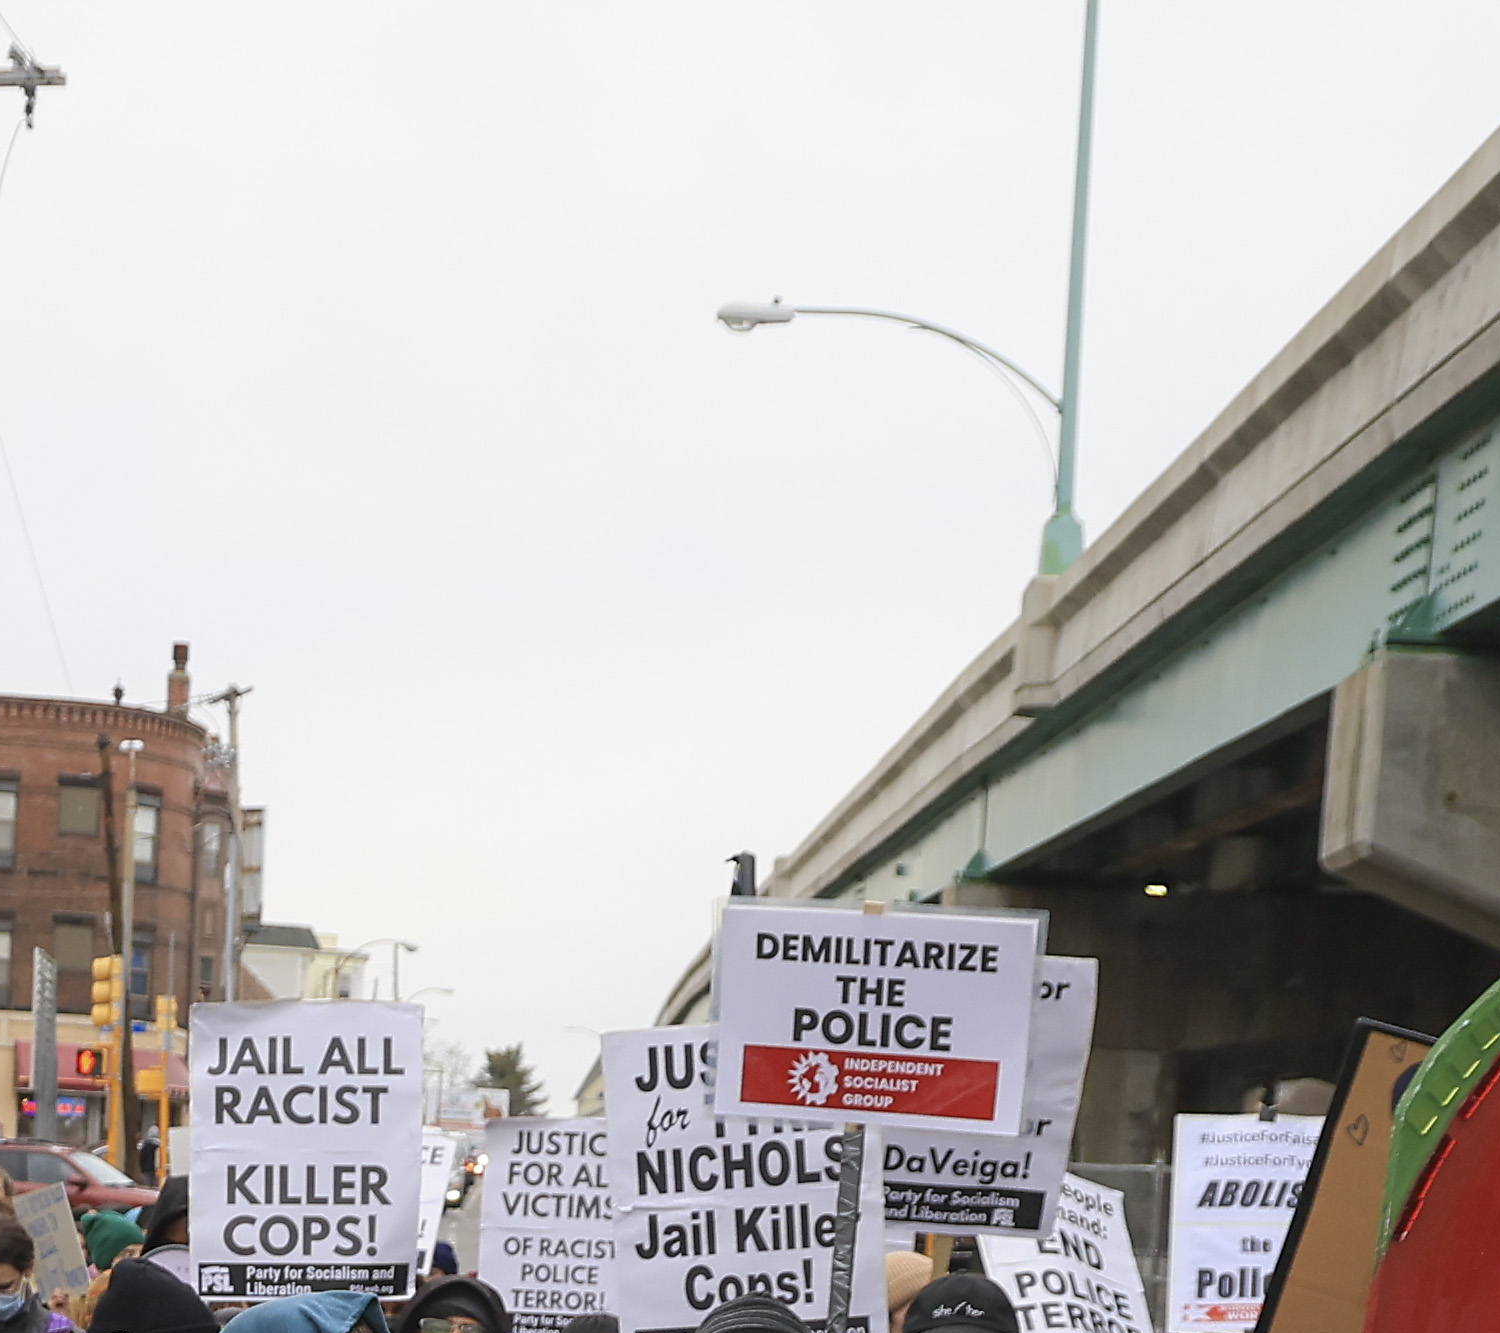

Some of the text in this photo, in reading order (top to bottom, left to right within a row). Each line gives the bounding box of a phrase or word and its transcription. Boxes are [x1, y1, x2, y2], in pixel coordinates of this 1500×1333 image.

[756, 932, 999, 973] DEMILITARIZE
[836, 975, 906, 1008] THE
[792, 1007, 954, 1052] POLICE
[208, 1036, 405, 1076] JAIL ALL
[843, 1057, 945, 1077] INDEPENDENT
[842, 1075, 919, 1093] SOCIALIST
[214, 1085, 388, 1125] RACIST
[841, 1093, 894, 1108] GROUP
[645, 1096, 690, 1148] for
[512, 1130, 608, 1156] JUSTIC
[1200, 1130, 1320, 1144] #JusticeForFaisa
[508, 1161, 610, 1188] FOR AL
[637, 1135, 845, 1195] NICHOLS
[883, 1144, 1032, 1184] DaVeiga!
[226, 1164, 392, 1206] KILLER
[925, 1188, 948, 1203] for
[950, 1191, 1020, 1208] Socialism
[1198, 1179, 1306, 1208] ABOLIS
[502, 1191, 613, 1219] VICTIMS
[911, 1205, 987, 1222] Liberation
[1062, 1186, 1115, 1217] eople
[223, 1215, 378, 1257] COPS!
[635, 1203, 845, 1259] Jail Kille
[1241, 1235, 1272, 1253] the
[504, 1236, 616, 1259] OF RACIST
[201, 1267, 234, 1292] PSL
[246, 1265, 395, 1282] Party for Socialism and
[521, 1263, 599, 1285] POLICE
[246, 1282, 312, 1295] Liberation
[512, 1289, 606, 1311] TERROR!
[1015, 1268, 1133, 1321] POLICE
[513, 1315, 539, 1327] Party
[541, 1315, 553, 1325] for
